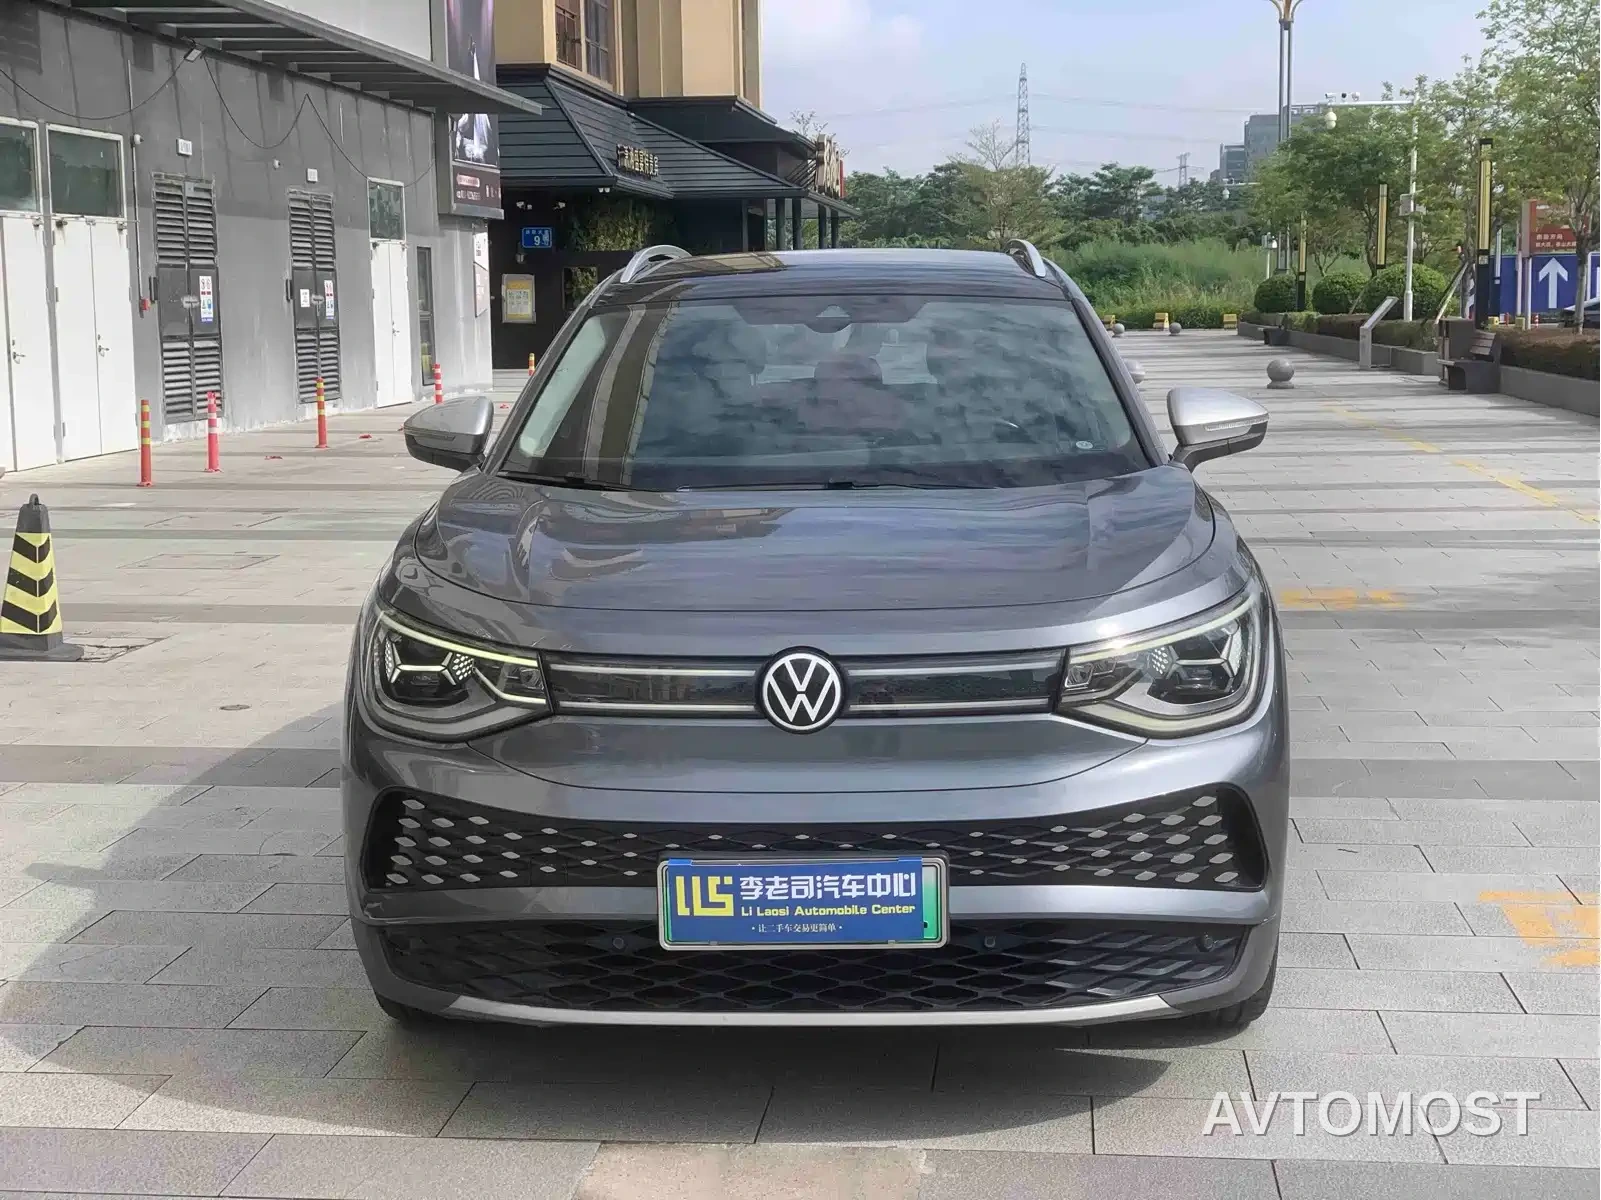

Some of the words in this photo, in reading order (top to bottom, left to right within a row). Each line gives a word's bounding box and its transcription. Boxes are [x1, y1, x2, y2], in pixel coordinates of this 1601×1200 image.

[739, 872, 916, 900] 李老司汽车中心
[741, 905, 752, 917] Li
[757, 905, 789, 917] Laosi
[794, 905, 867, 916] Automobile
[871, 904, 916, 915] Center
